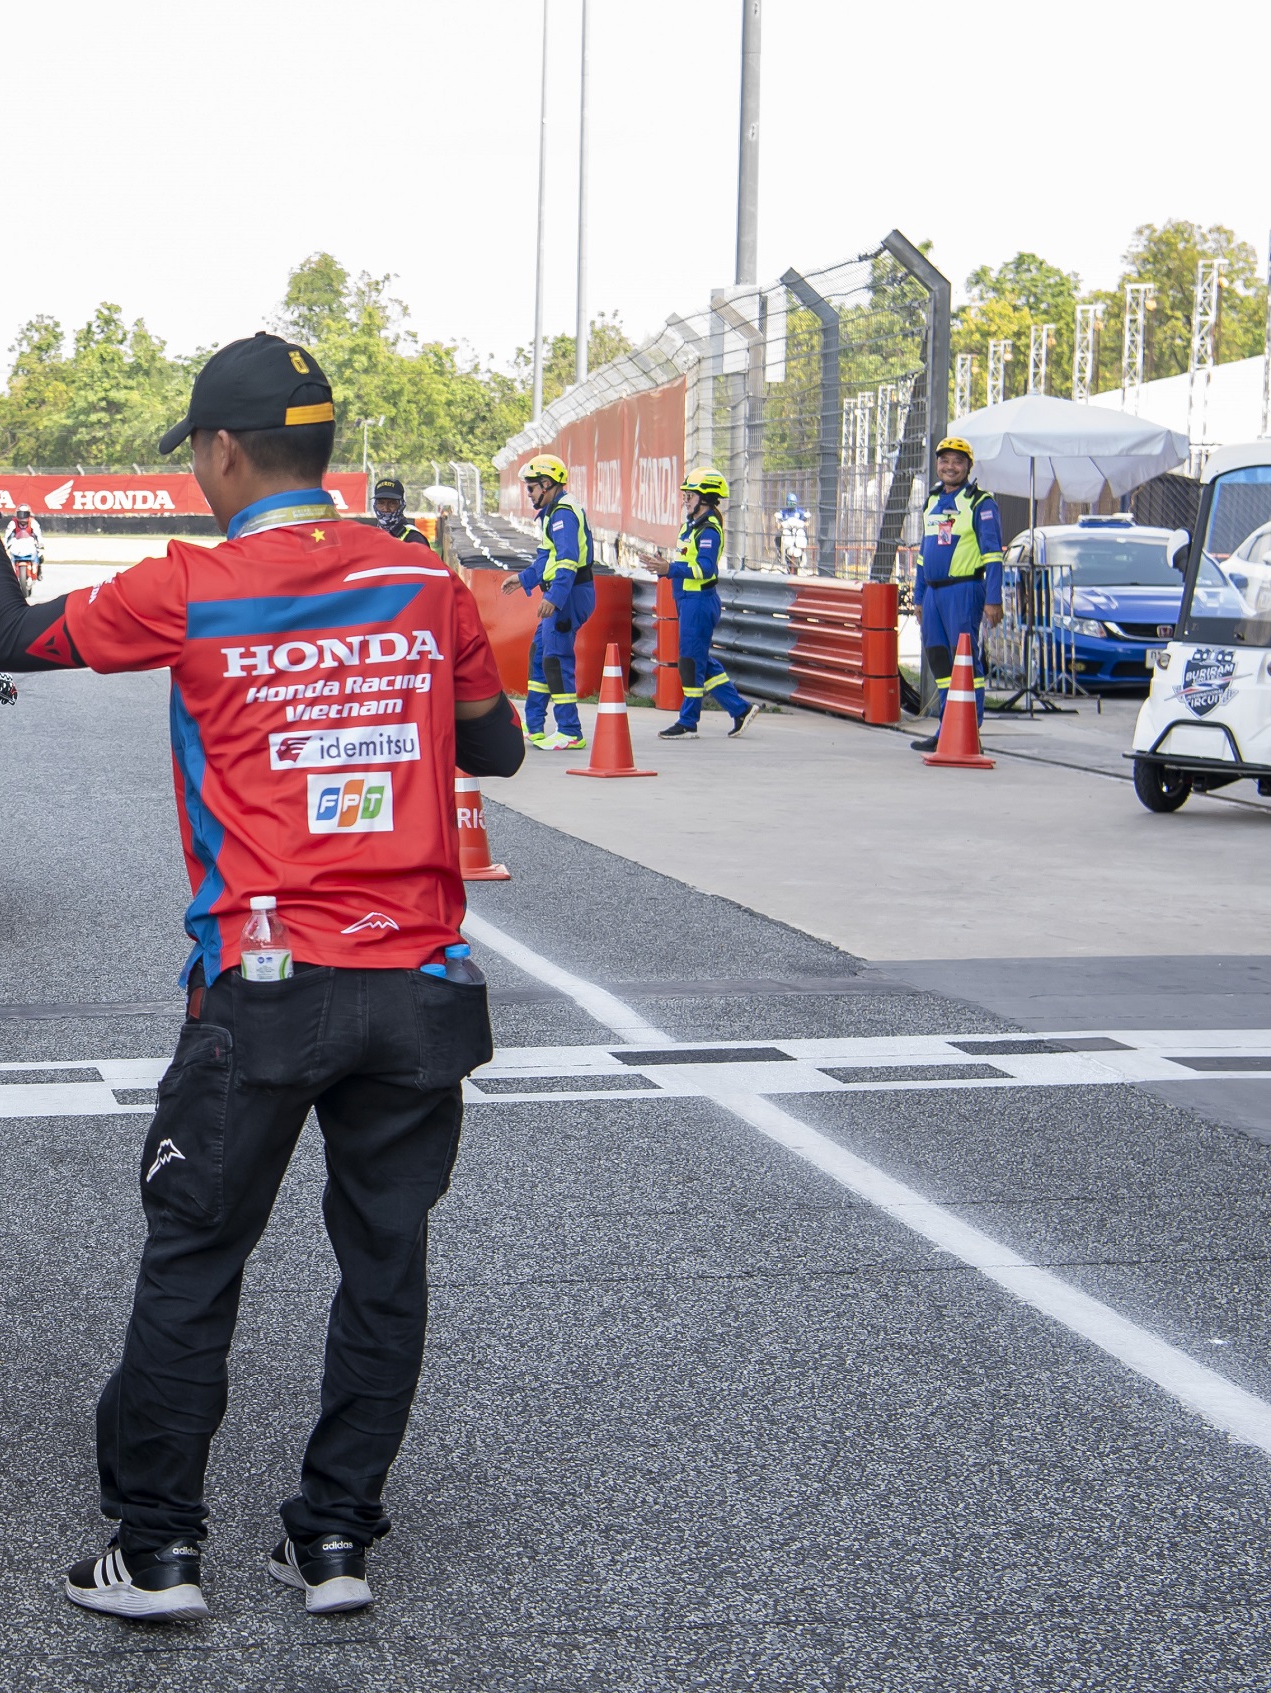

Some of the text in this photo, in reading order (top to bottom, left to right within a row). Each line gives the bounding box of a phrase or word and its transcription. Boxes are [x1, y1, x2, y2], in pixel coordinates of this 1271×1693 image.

[72, 490, 175, 510] HONDA
[221, 630, 444, 677] HONDA
[1186, 664, 1234, 681] BURIRAM
[246, 673, 431, 704] Honda Racing
[286, 698, 403, 723] Vietnam
[319, 732, 414, 760] idemitsu
[316, 779, 385, 828] FPT
[322, 1540, 354, 1551] adidas
